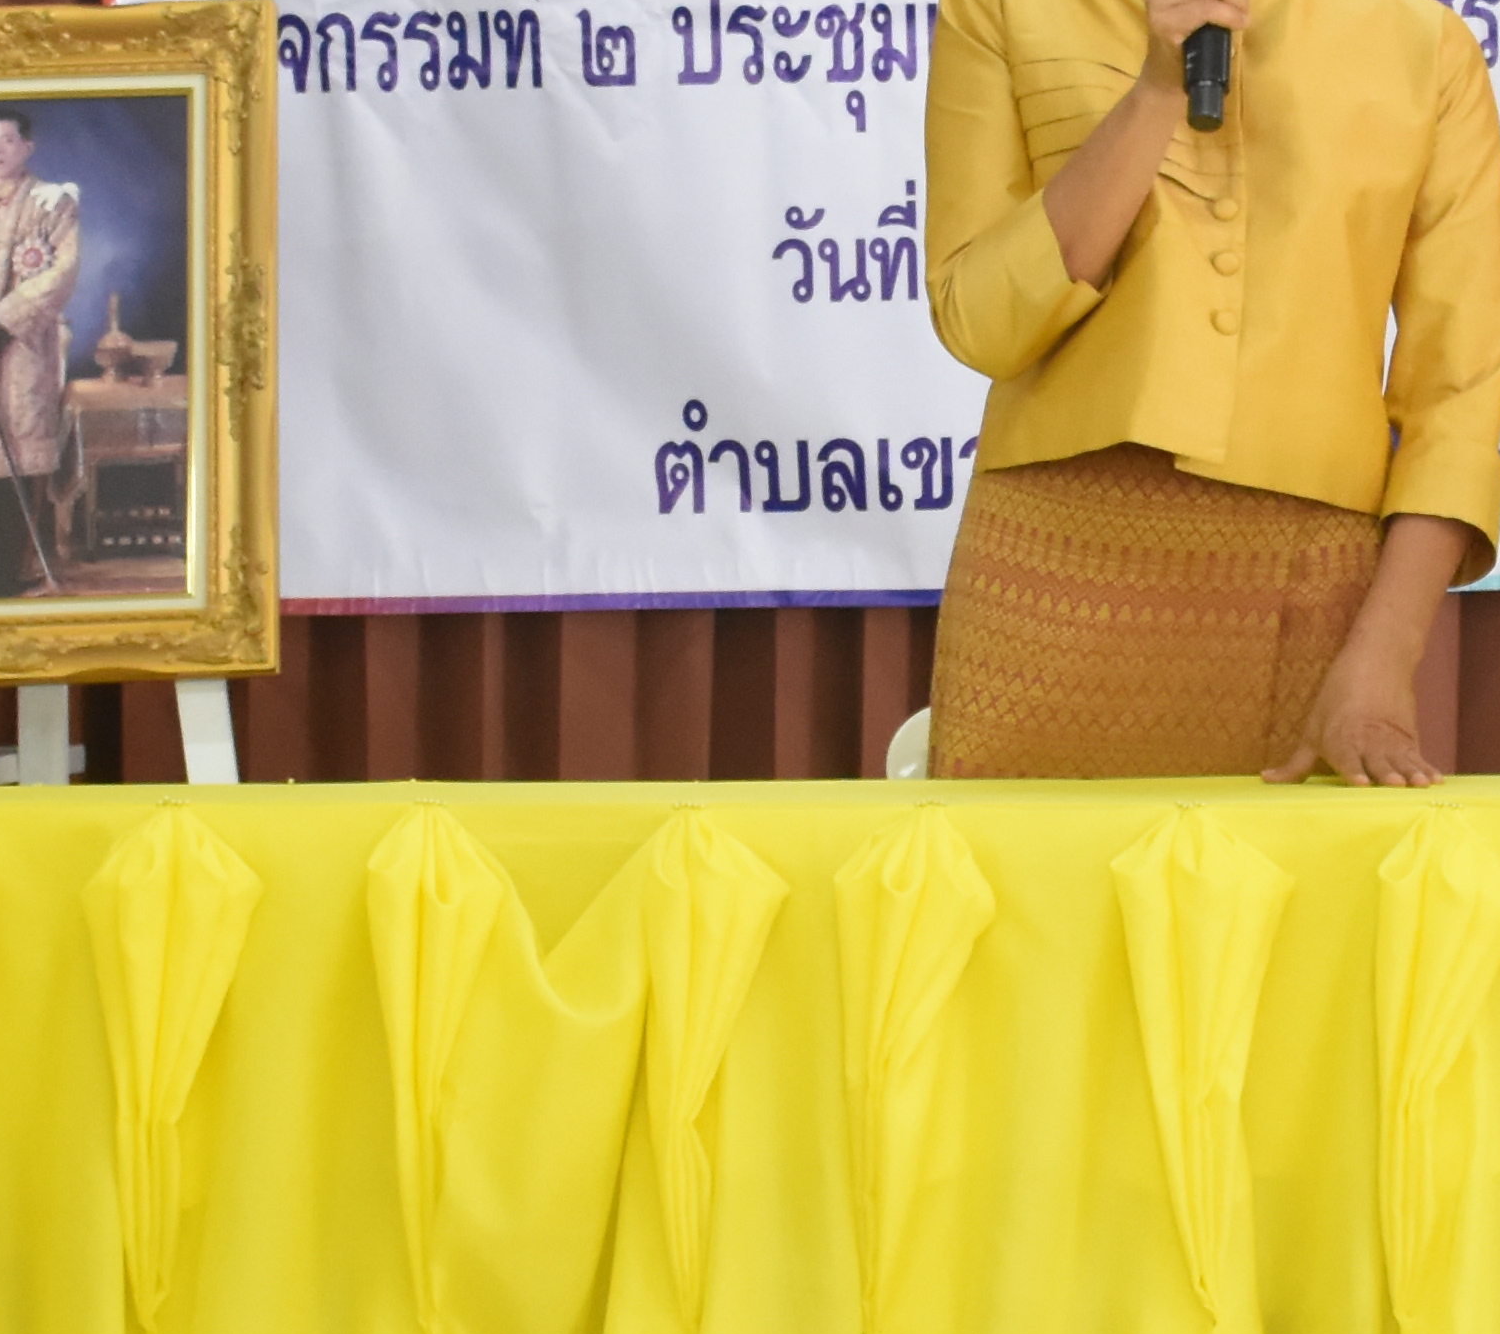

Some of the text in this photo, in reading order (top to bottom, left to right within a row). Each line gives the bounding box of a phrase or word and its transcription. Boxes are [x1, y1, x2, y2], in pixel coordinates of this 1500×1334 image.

[576, 8, 637, 87] ๒
[772, 180, 919, 303] วันที่
[655, 399, 980, 515] ตำบลเข
